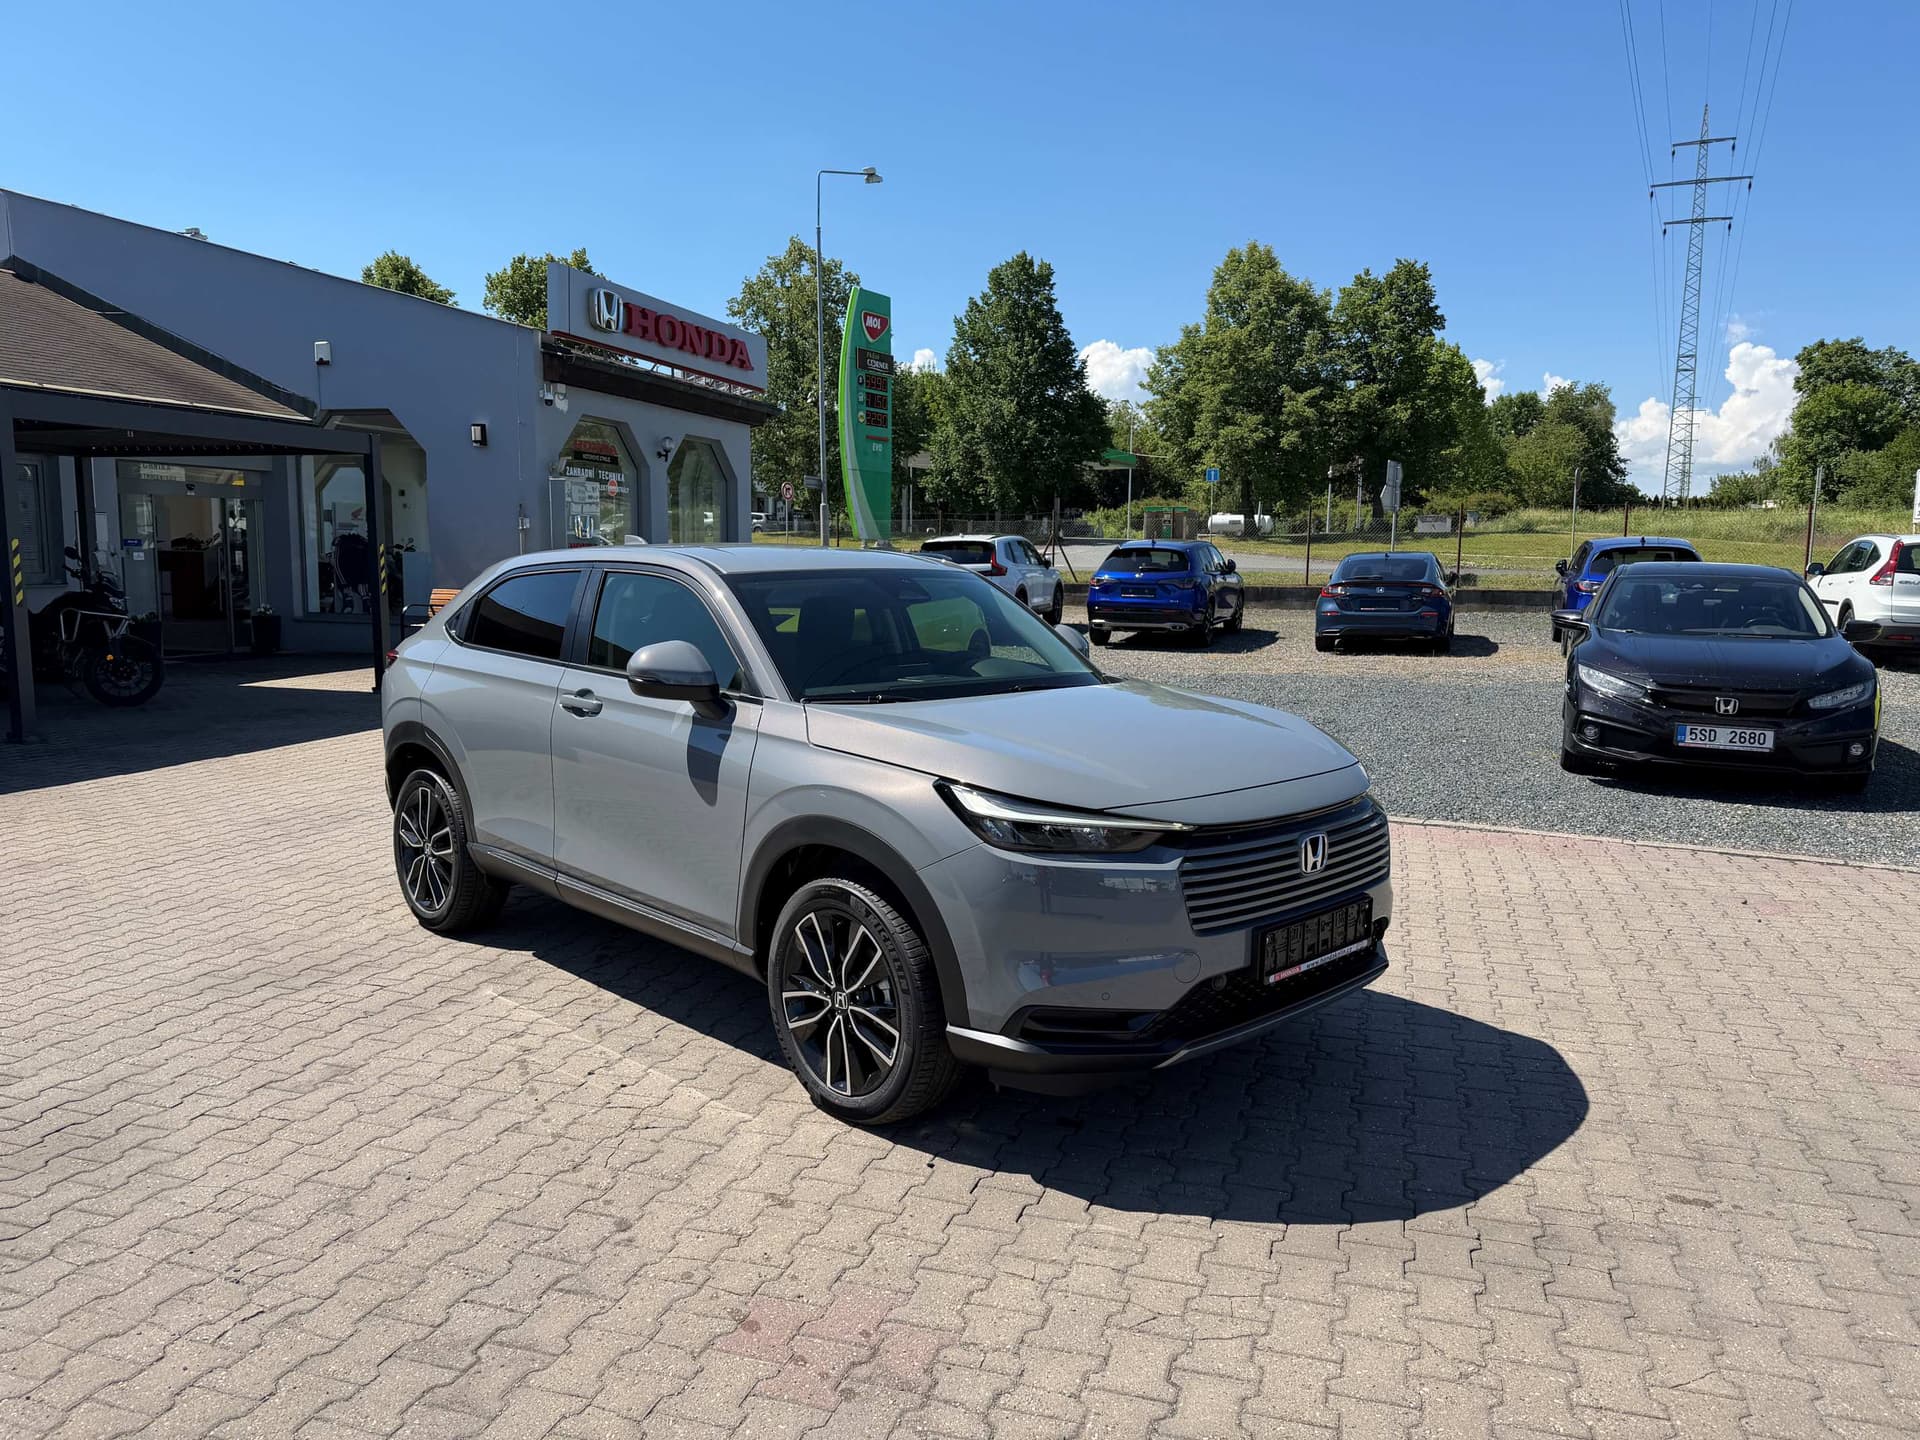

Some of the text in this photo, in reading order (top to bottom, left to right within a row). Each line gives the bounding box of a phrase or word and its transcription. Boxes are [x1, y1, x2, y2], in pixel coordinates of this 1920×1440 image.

[866, 314, 881, 330] MOL
[624, 302, 754, 371] HONDA
[598, 470, 625, 482] TECHNIKA
[1689, 728, 1767, 745] 5SD 2680
